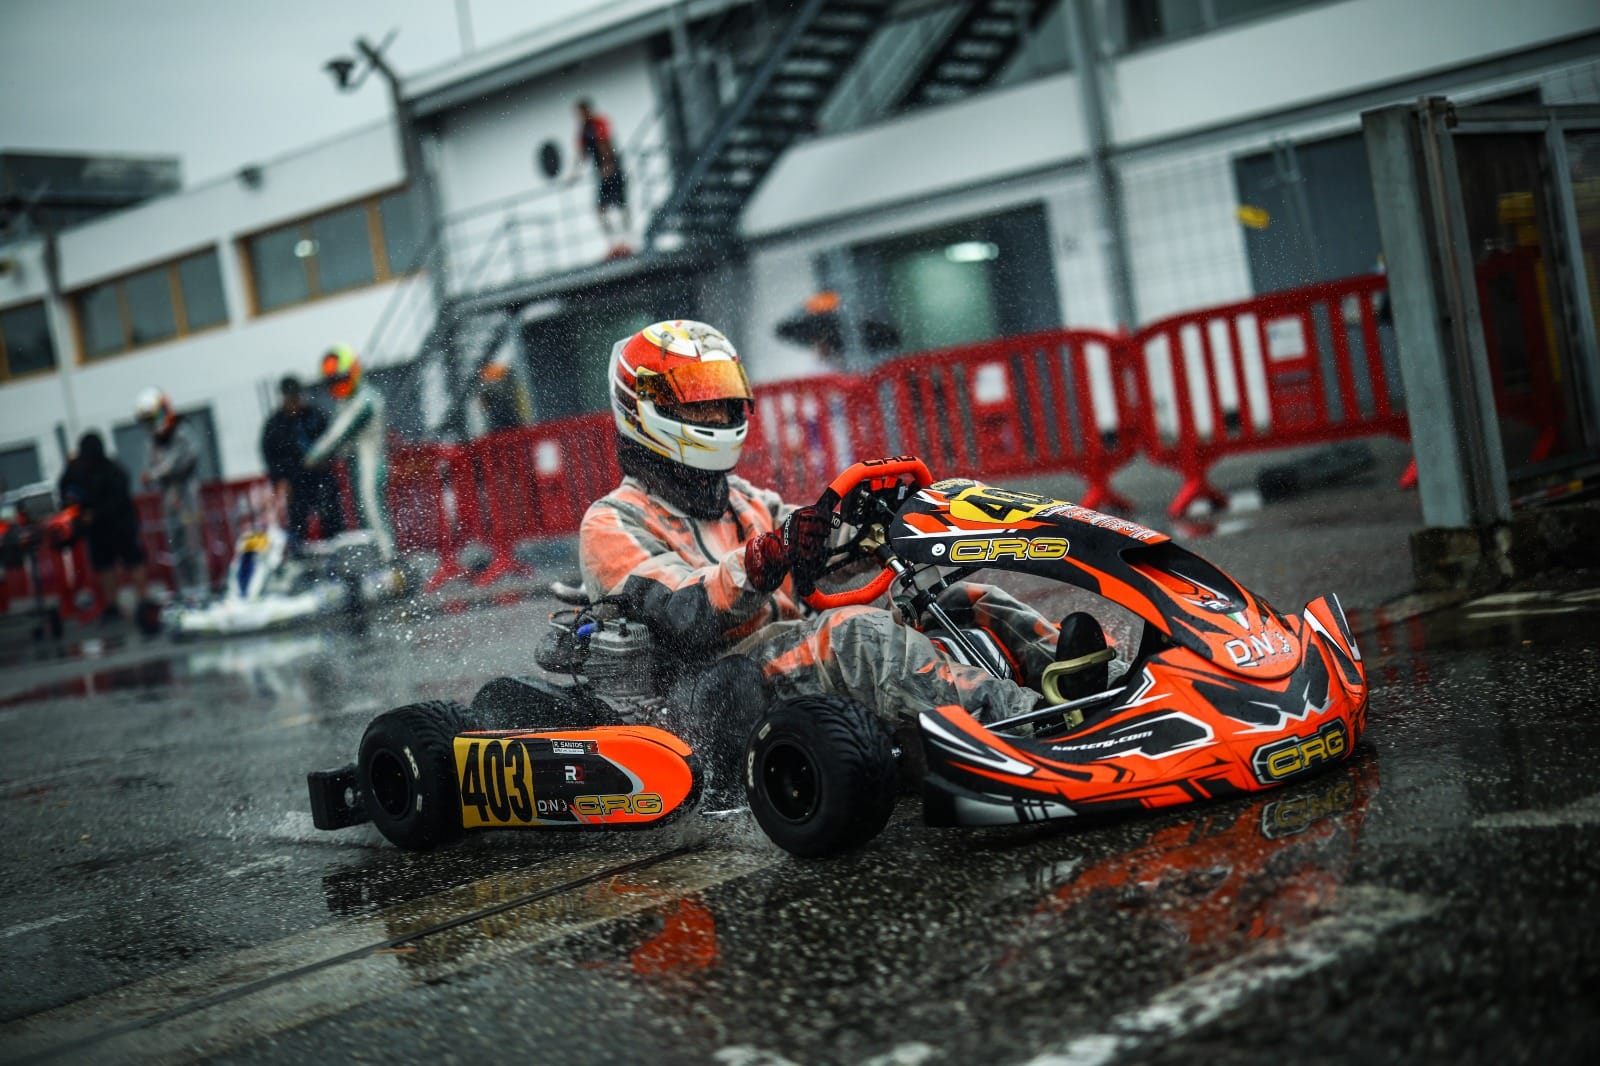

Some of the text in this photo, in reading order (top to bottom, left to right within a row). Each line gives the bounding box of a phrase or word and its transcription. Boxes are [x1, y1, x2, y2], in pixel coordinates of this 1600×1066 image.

[950, 537, 1069, 562] CRG
[1051, 730, 1153, 751] kartcrg.com
[1266, 728, 1346, 779] CRG
[461, 740, 533, 823] 403
[574, 793, 663, 816] CRG
